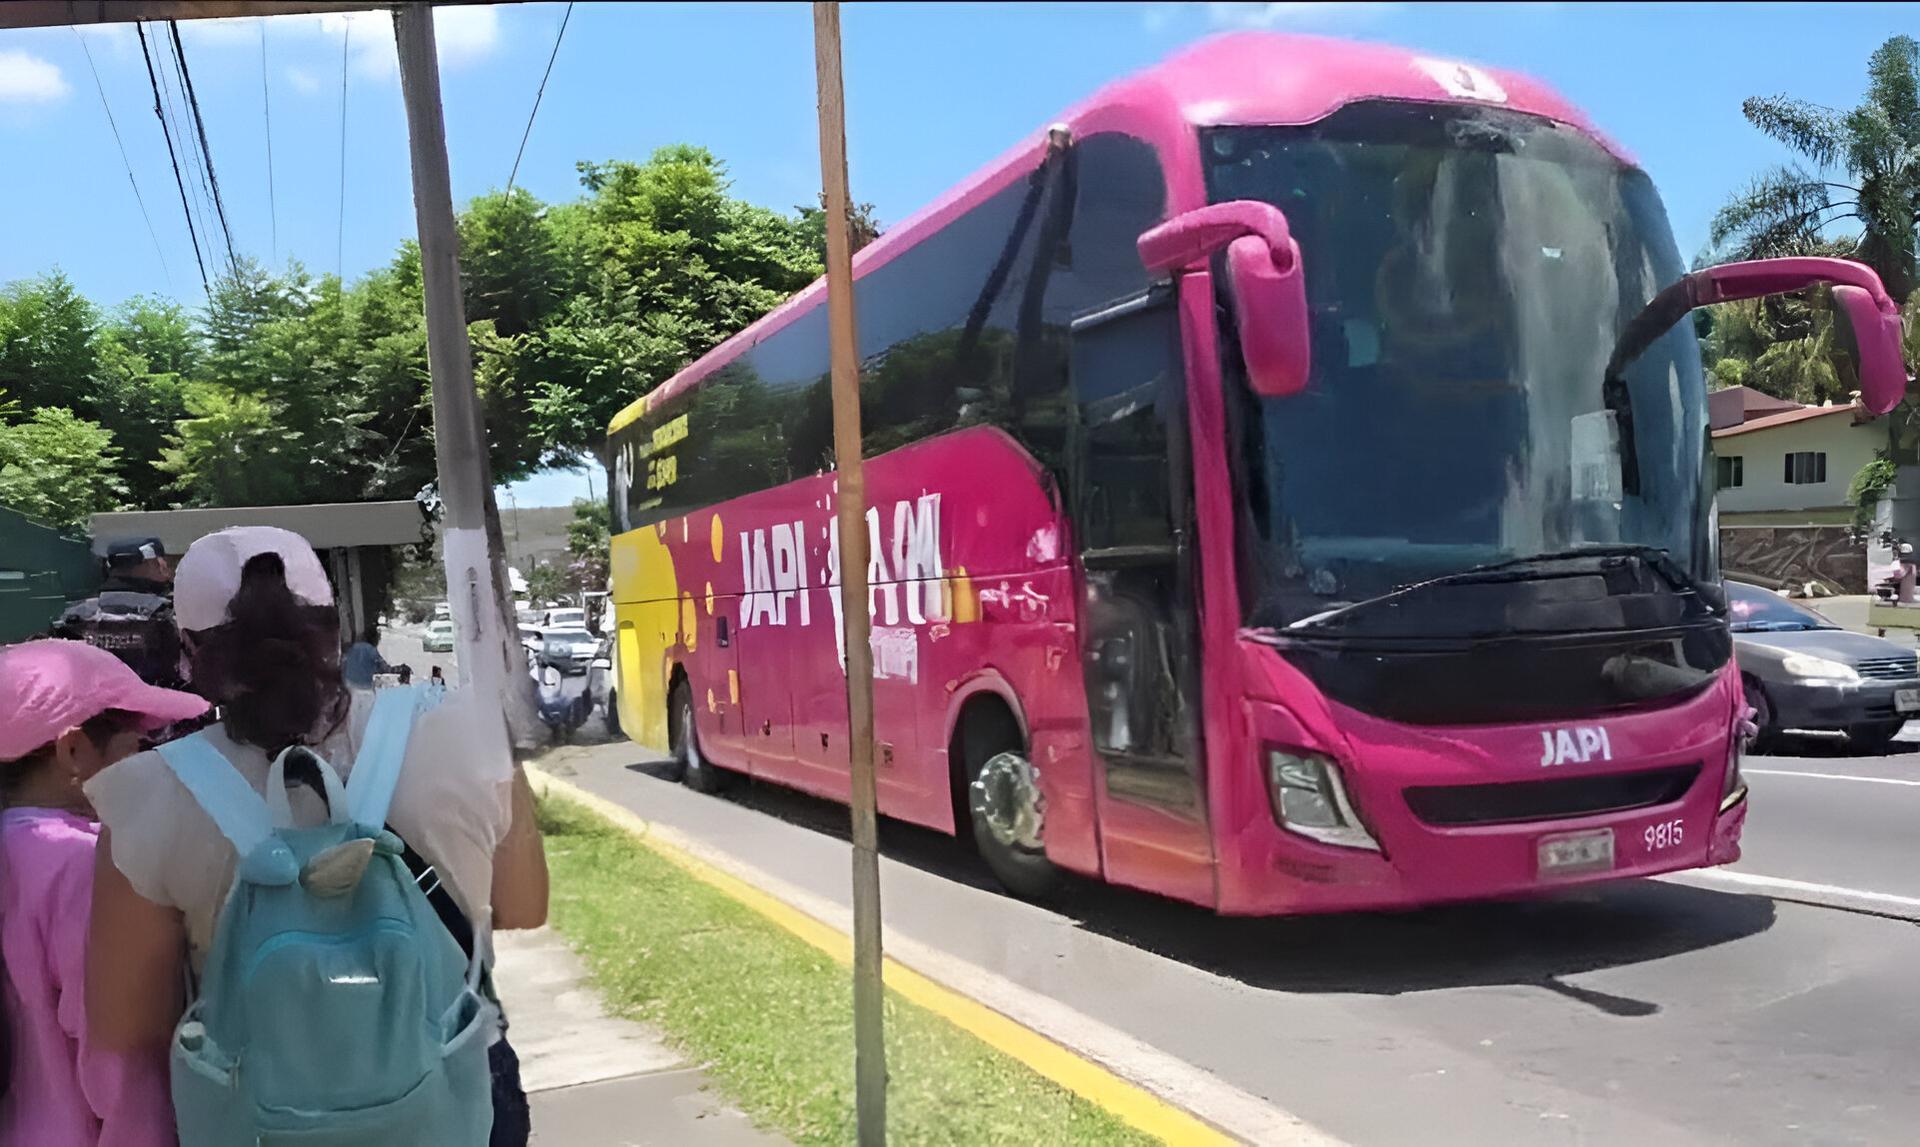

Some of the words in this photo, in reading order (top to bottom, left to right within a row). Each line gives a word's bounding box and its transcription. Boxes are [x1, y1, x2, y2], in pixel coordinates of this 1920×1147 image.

[739, 519, 810, 629] JAPI
[1541, 725, 1612, 767] JAPI
[1645, 819, 1684, 851] 9815
